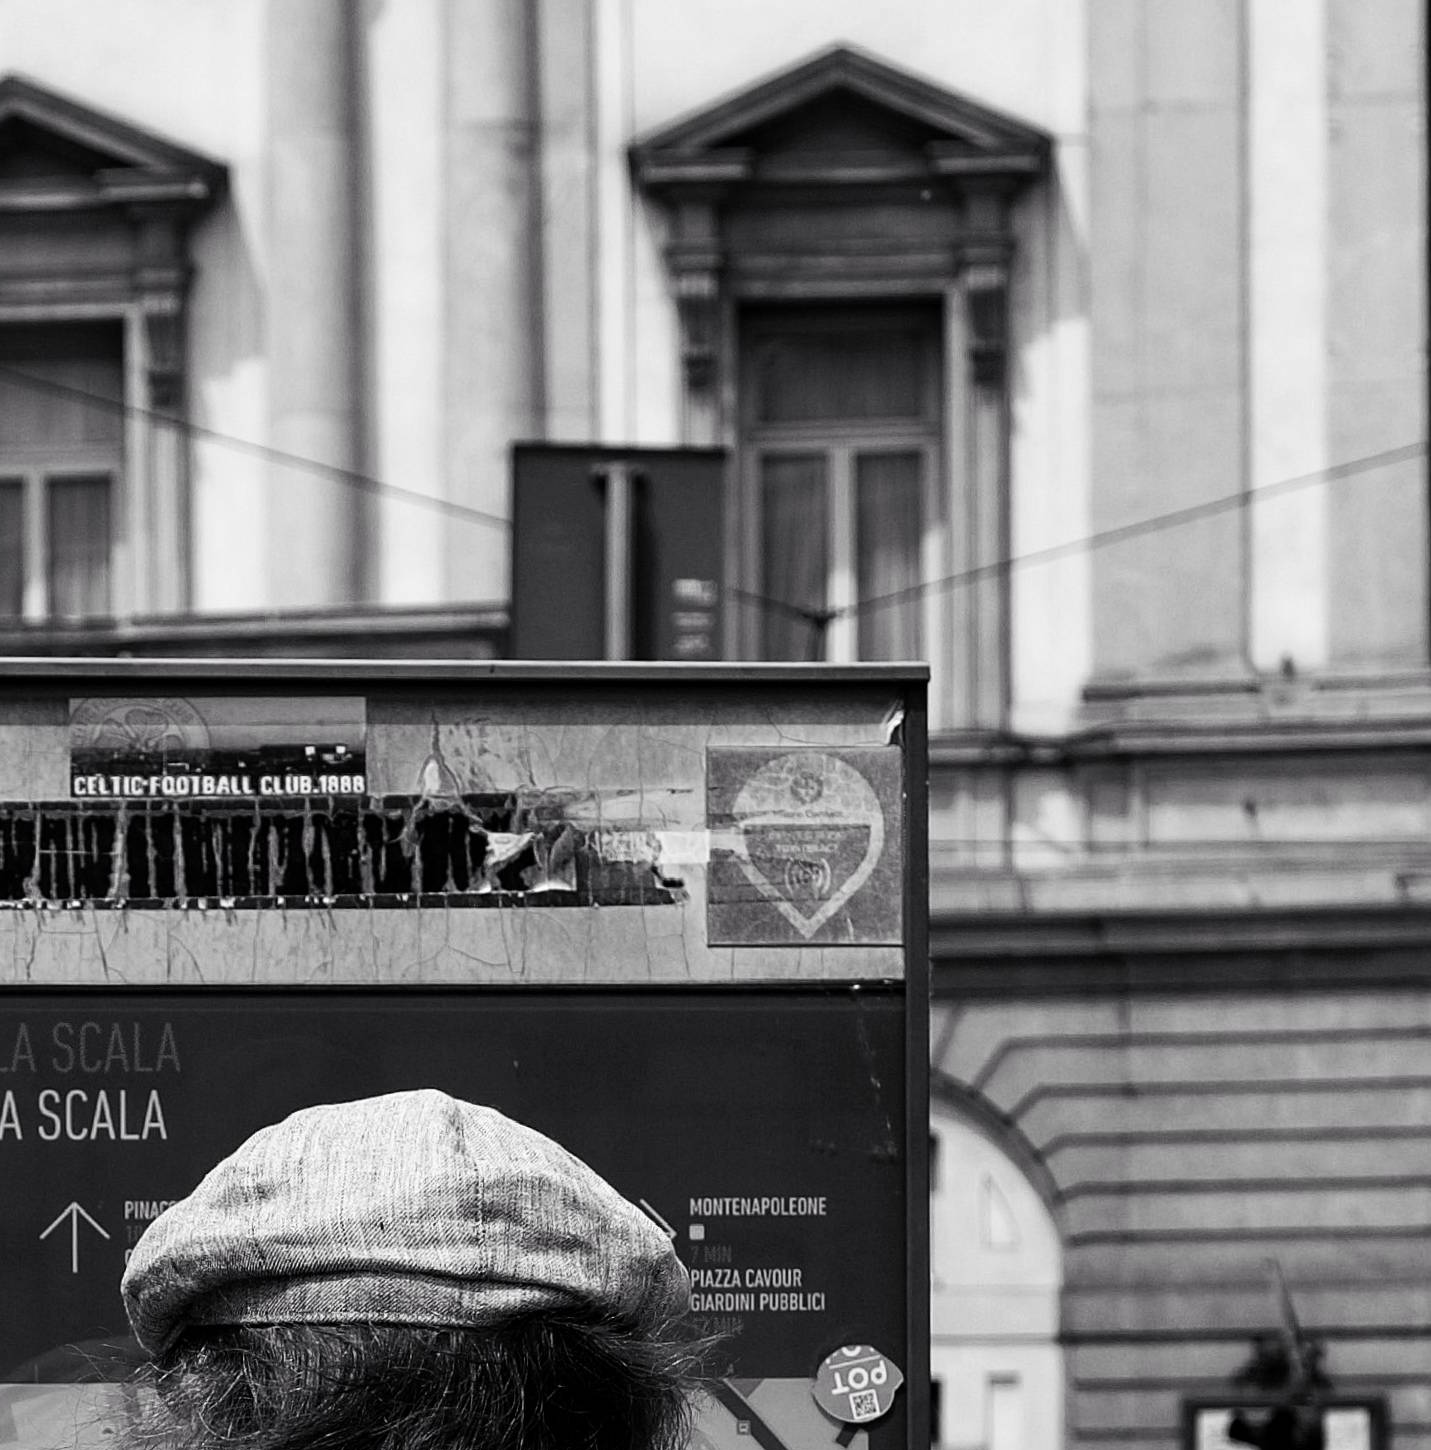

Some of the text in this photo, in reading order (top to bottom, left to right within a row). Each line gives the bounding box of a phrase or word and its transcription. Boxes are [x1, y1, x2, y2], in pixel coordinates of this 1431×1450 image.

[52, 1022, 181, 1073] SCALA
[38, 1089, 167, 1141] SCALA
[689, 1197, 827, 1216] MONTENAPOLEONE
[690, 1268, 802, 1288] PIAZZA CAVOUR
[690, 1292, 825, 1311] GIARDINI PUBBLICI
